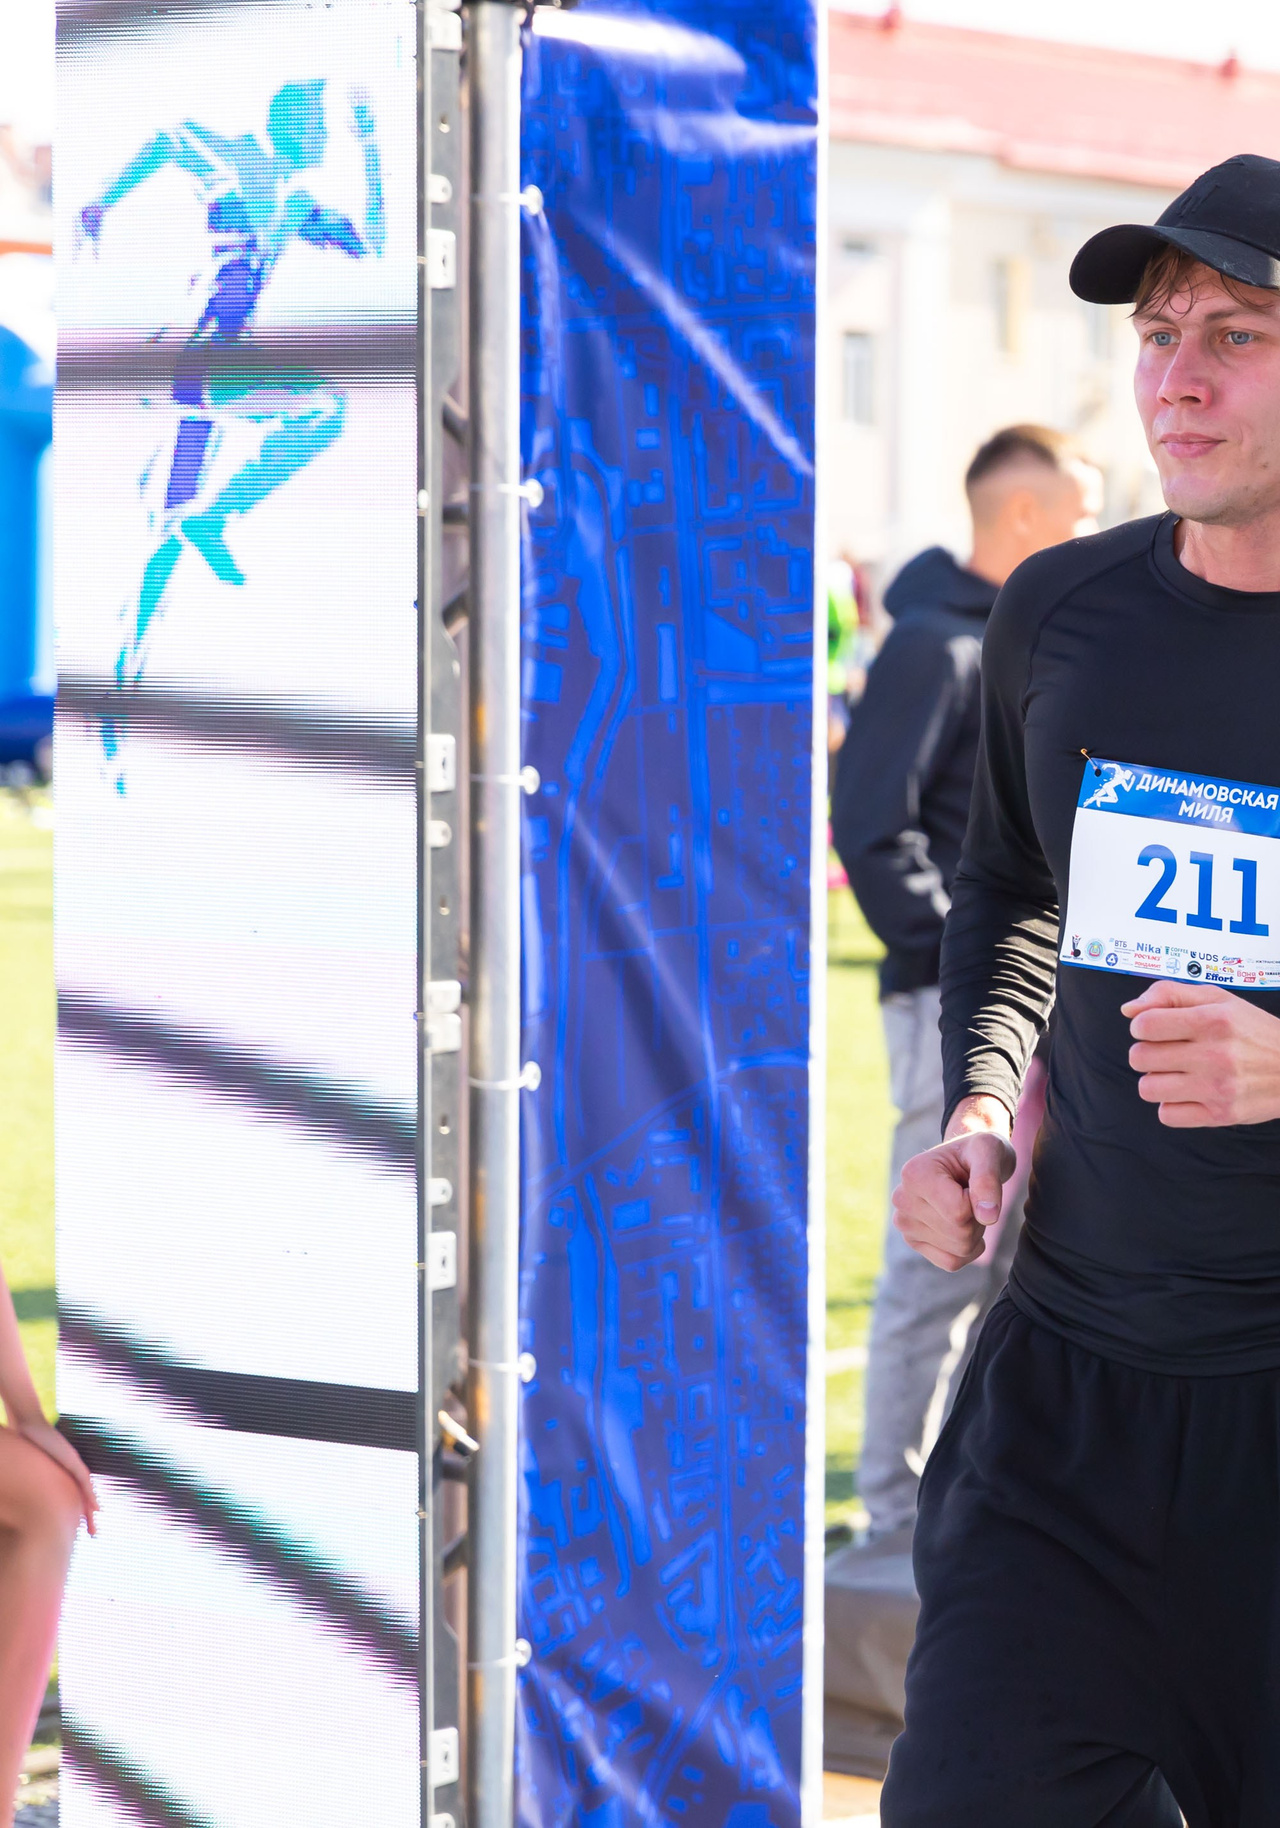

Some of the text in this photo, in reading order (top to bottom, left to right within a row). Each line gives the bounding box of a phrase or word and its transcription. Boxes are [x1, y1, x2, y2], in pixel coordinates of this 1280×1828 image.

[1136, 773, 1279, 811] ДИНАМОВСКАЯ
[1178, 800, 1234, 824] МИЛЯ
[1135, 844, 1270, 937] 211
[1114, 939, 1128, 948] ВТБ
[1136, 942, 1161, 954] Nika
[1198, 952, 1219, 963] UDS
[1205, 972, 1234, 983] Effort
